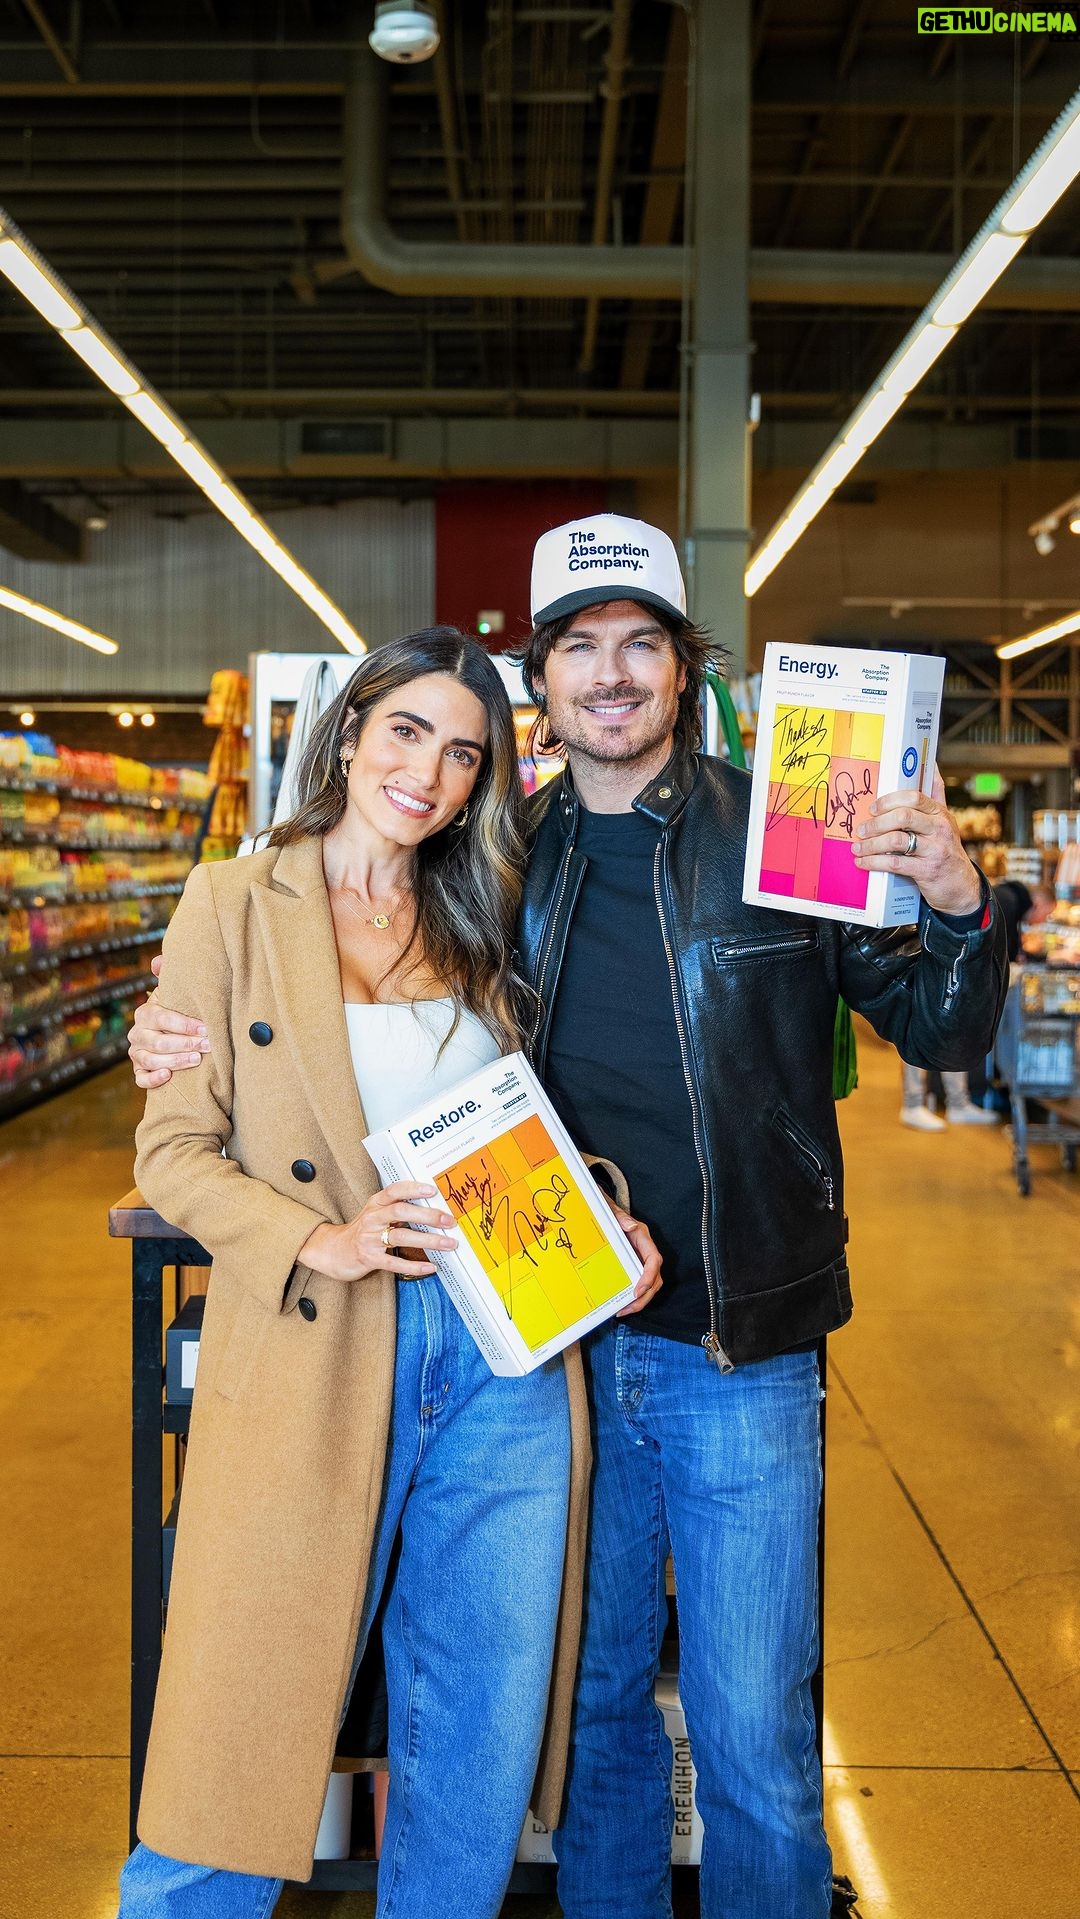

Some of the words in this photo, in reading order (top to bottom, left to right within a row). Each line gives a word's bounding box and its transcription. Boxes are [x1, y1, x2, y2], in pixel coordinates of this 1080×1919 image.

[568, 531, 595, 544] The
[568, 543, 649, 559] Absorption
[568, 558, 644, 571] Company.
[779, 655, 839, 679] Energy.
[865, 673, 889, 681] Company.
[504, 1071, 515, 1079] The
[491, 1075, 518, 1093] Absorption
[497, 1080, 522, 1096] Company.
[408, 1100, 481, 1147] Restore.
[674, 1736, 692, 1836] EREWHON
